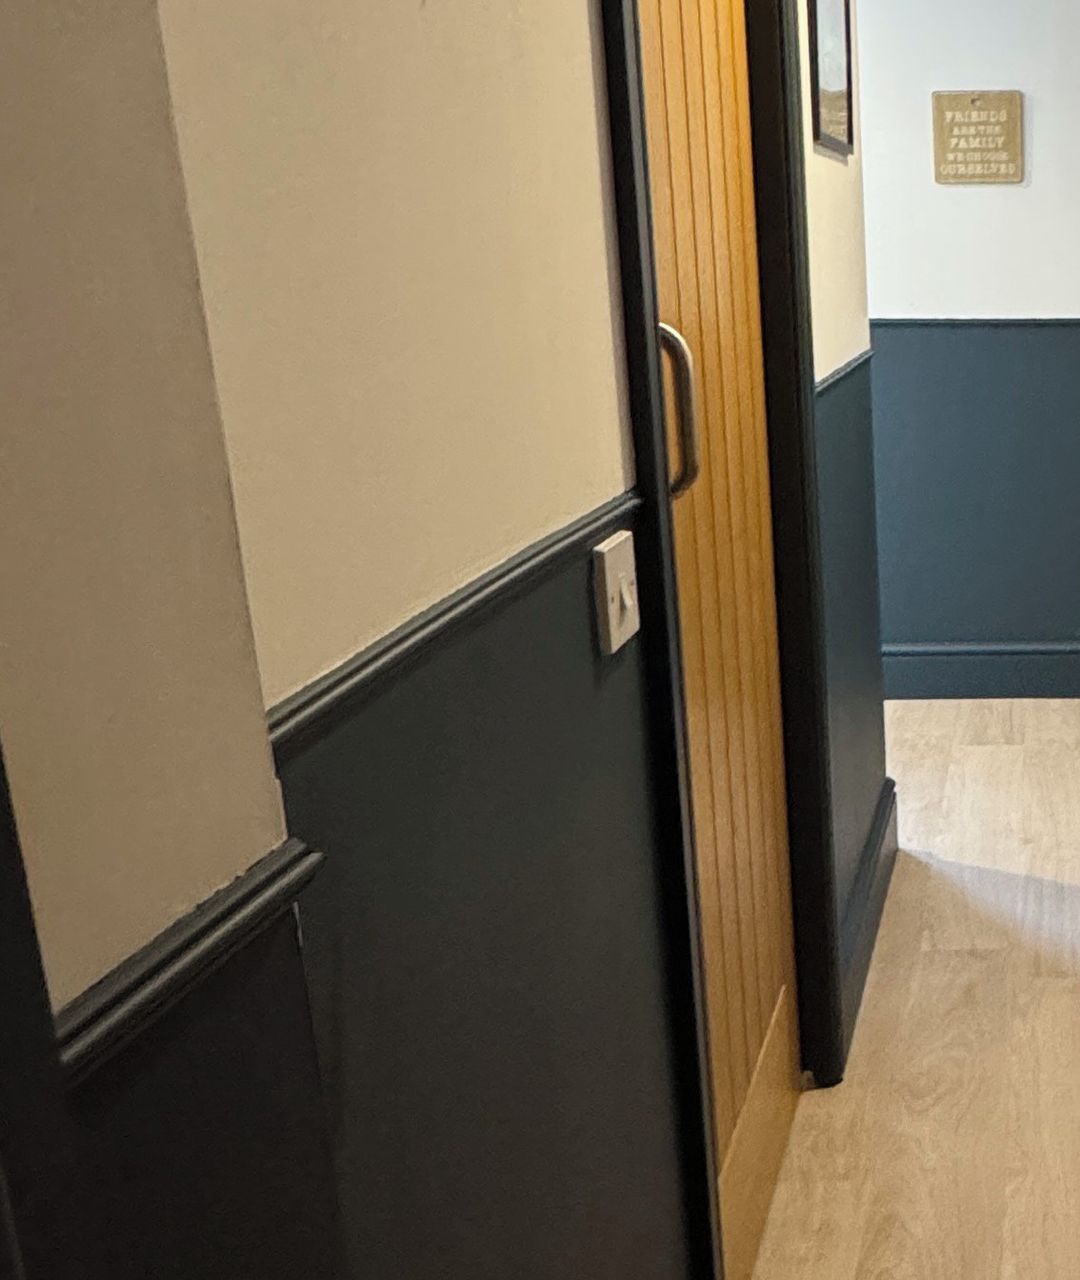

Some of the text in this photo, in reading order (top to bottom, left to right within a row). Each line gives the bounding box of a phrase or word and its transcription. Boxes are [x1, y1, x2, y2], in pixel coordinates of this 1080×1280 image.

[945, 110, 1007, 122] FRIENDS
[952, 124, 1002, 135] ARE THE
[950, 136, 1005, 148] FAMILY
